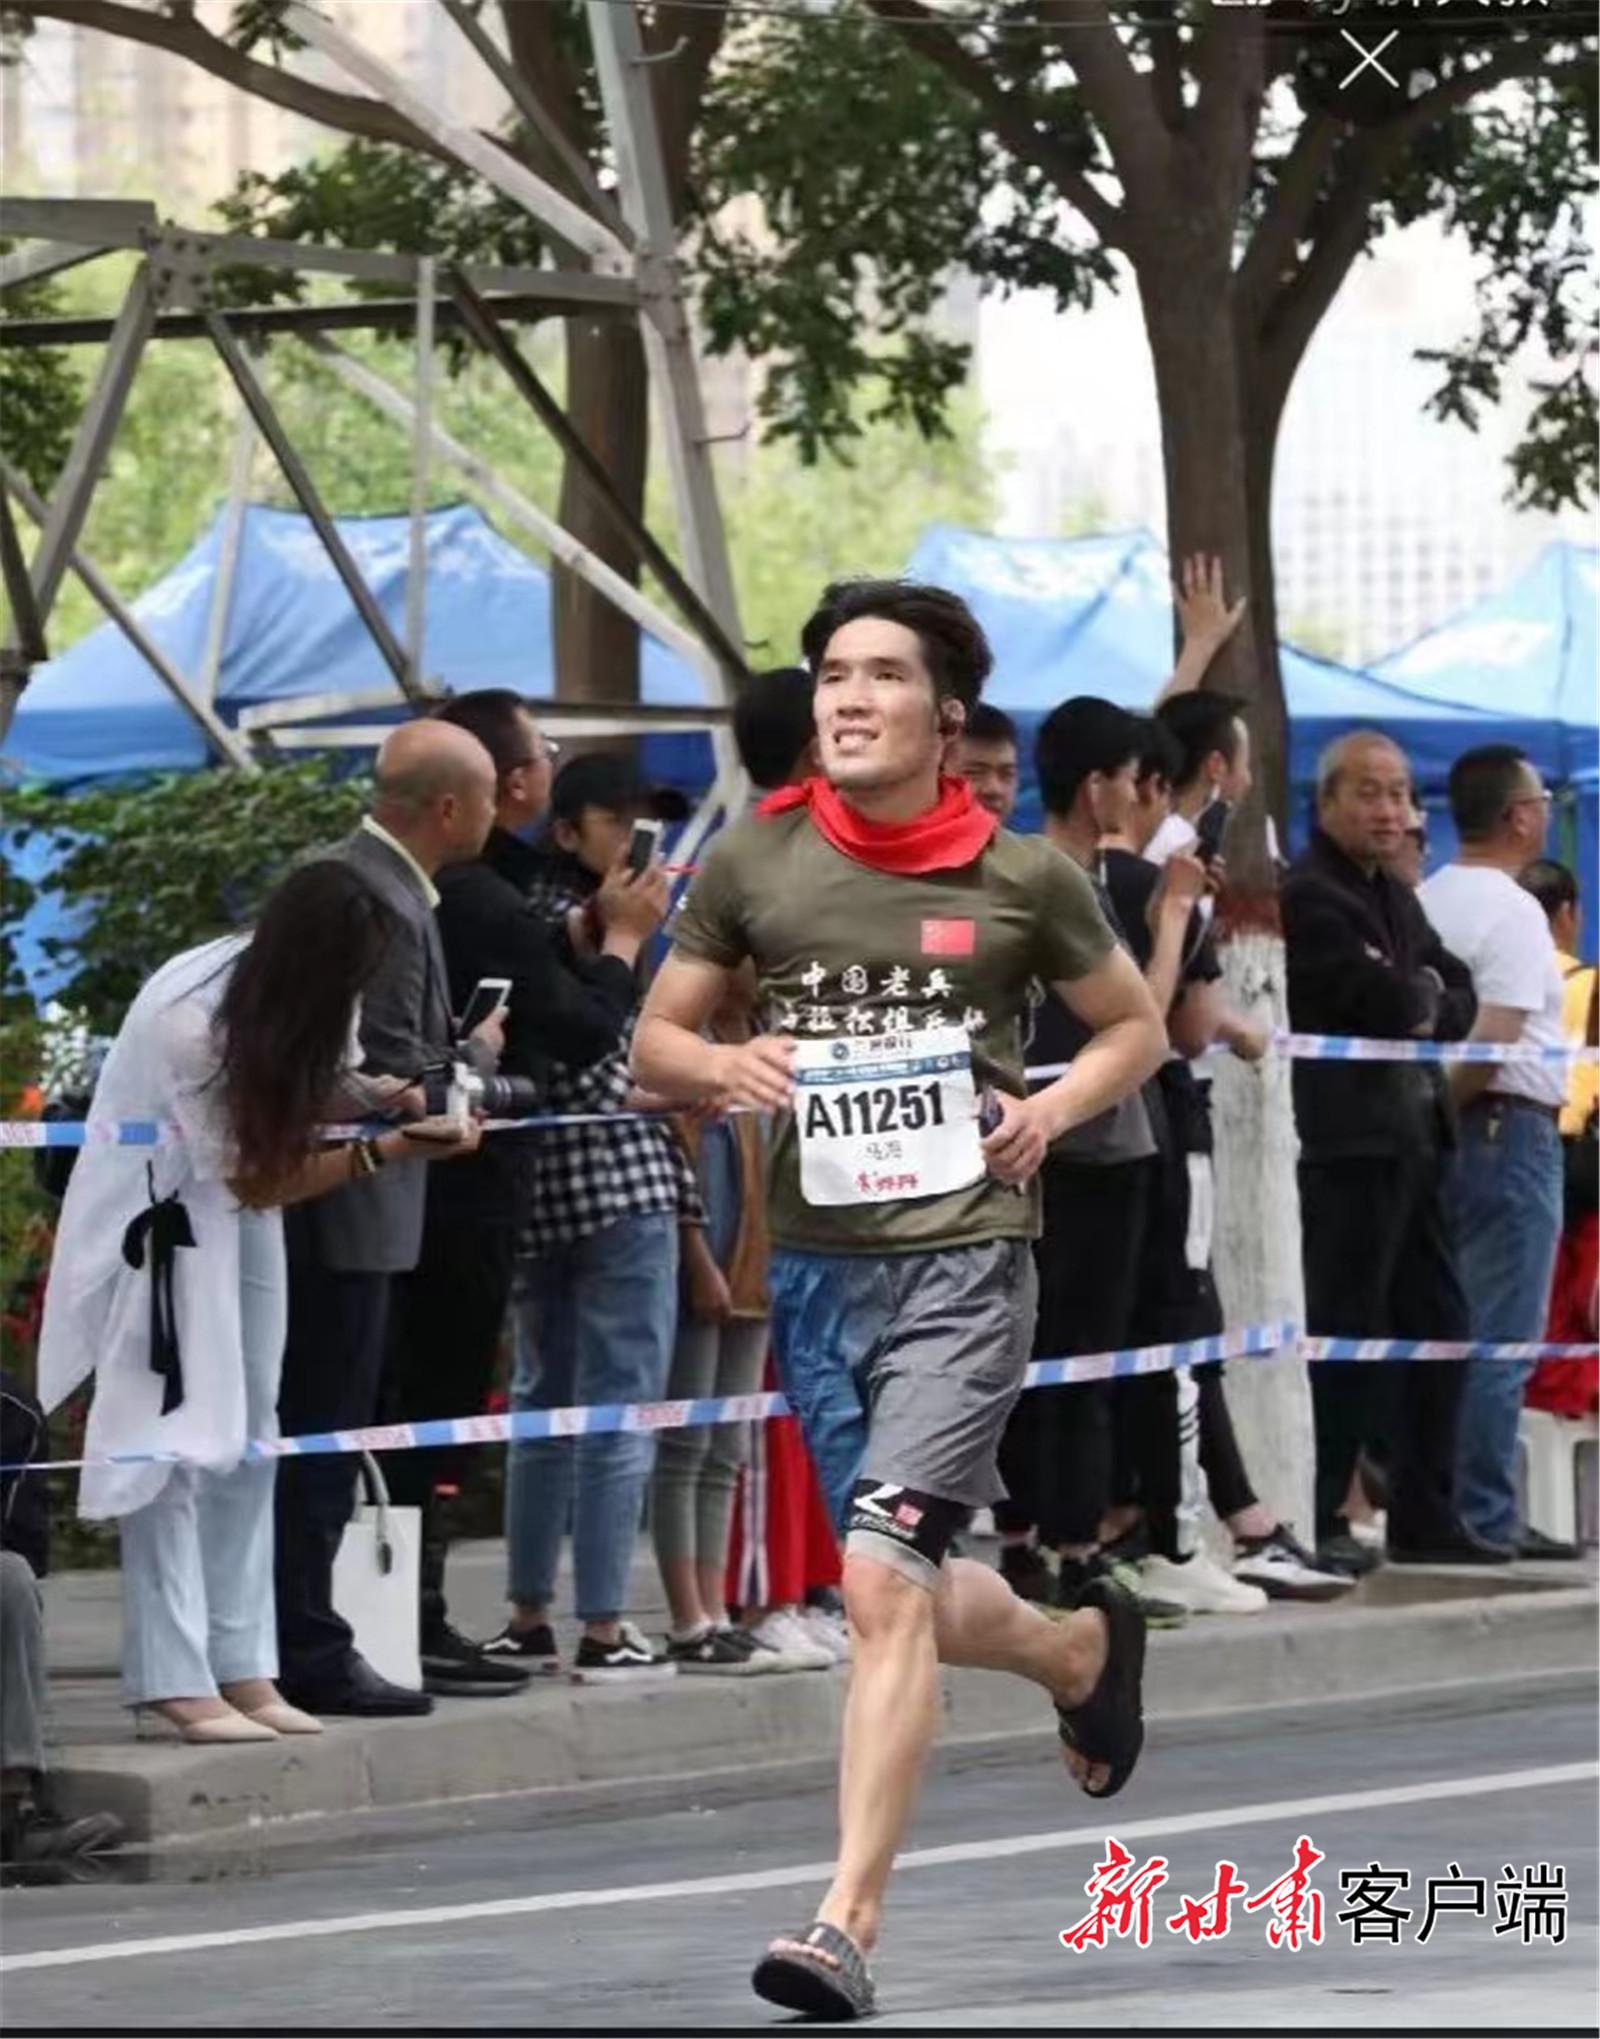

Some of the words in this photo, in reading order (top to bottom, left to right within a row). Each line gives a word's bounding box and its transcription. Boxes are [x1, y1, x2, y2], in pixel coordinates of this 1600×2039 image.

[801, 960, 953, 998] 中国老兵
[805, 1081, 945, 1139] A11251
